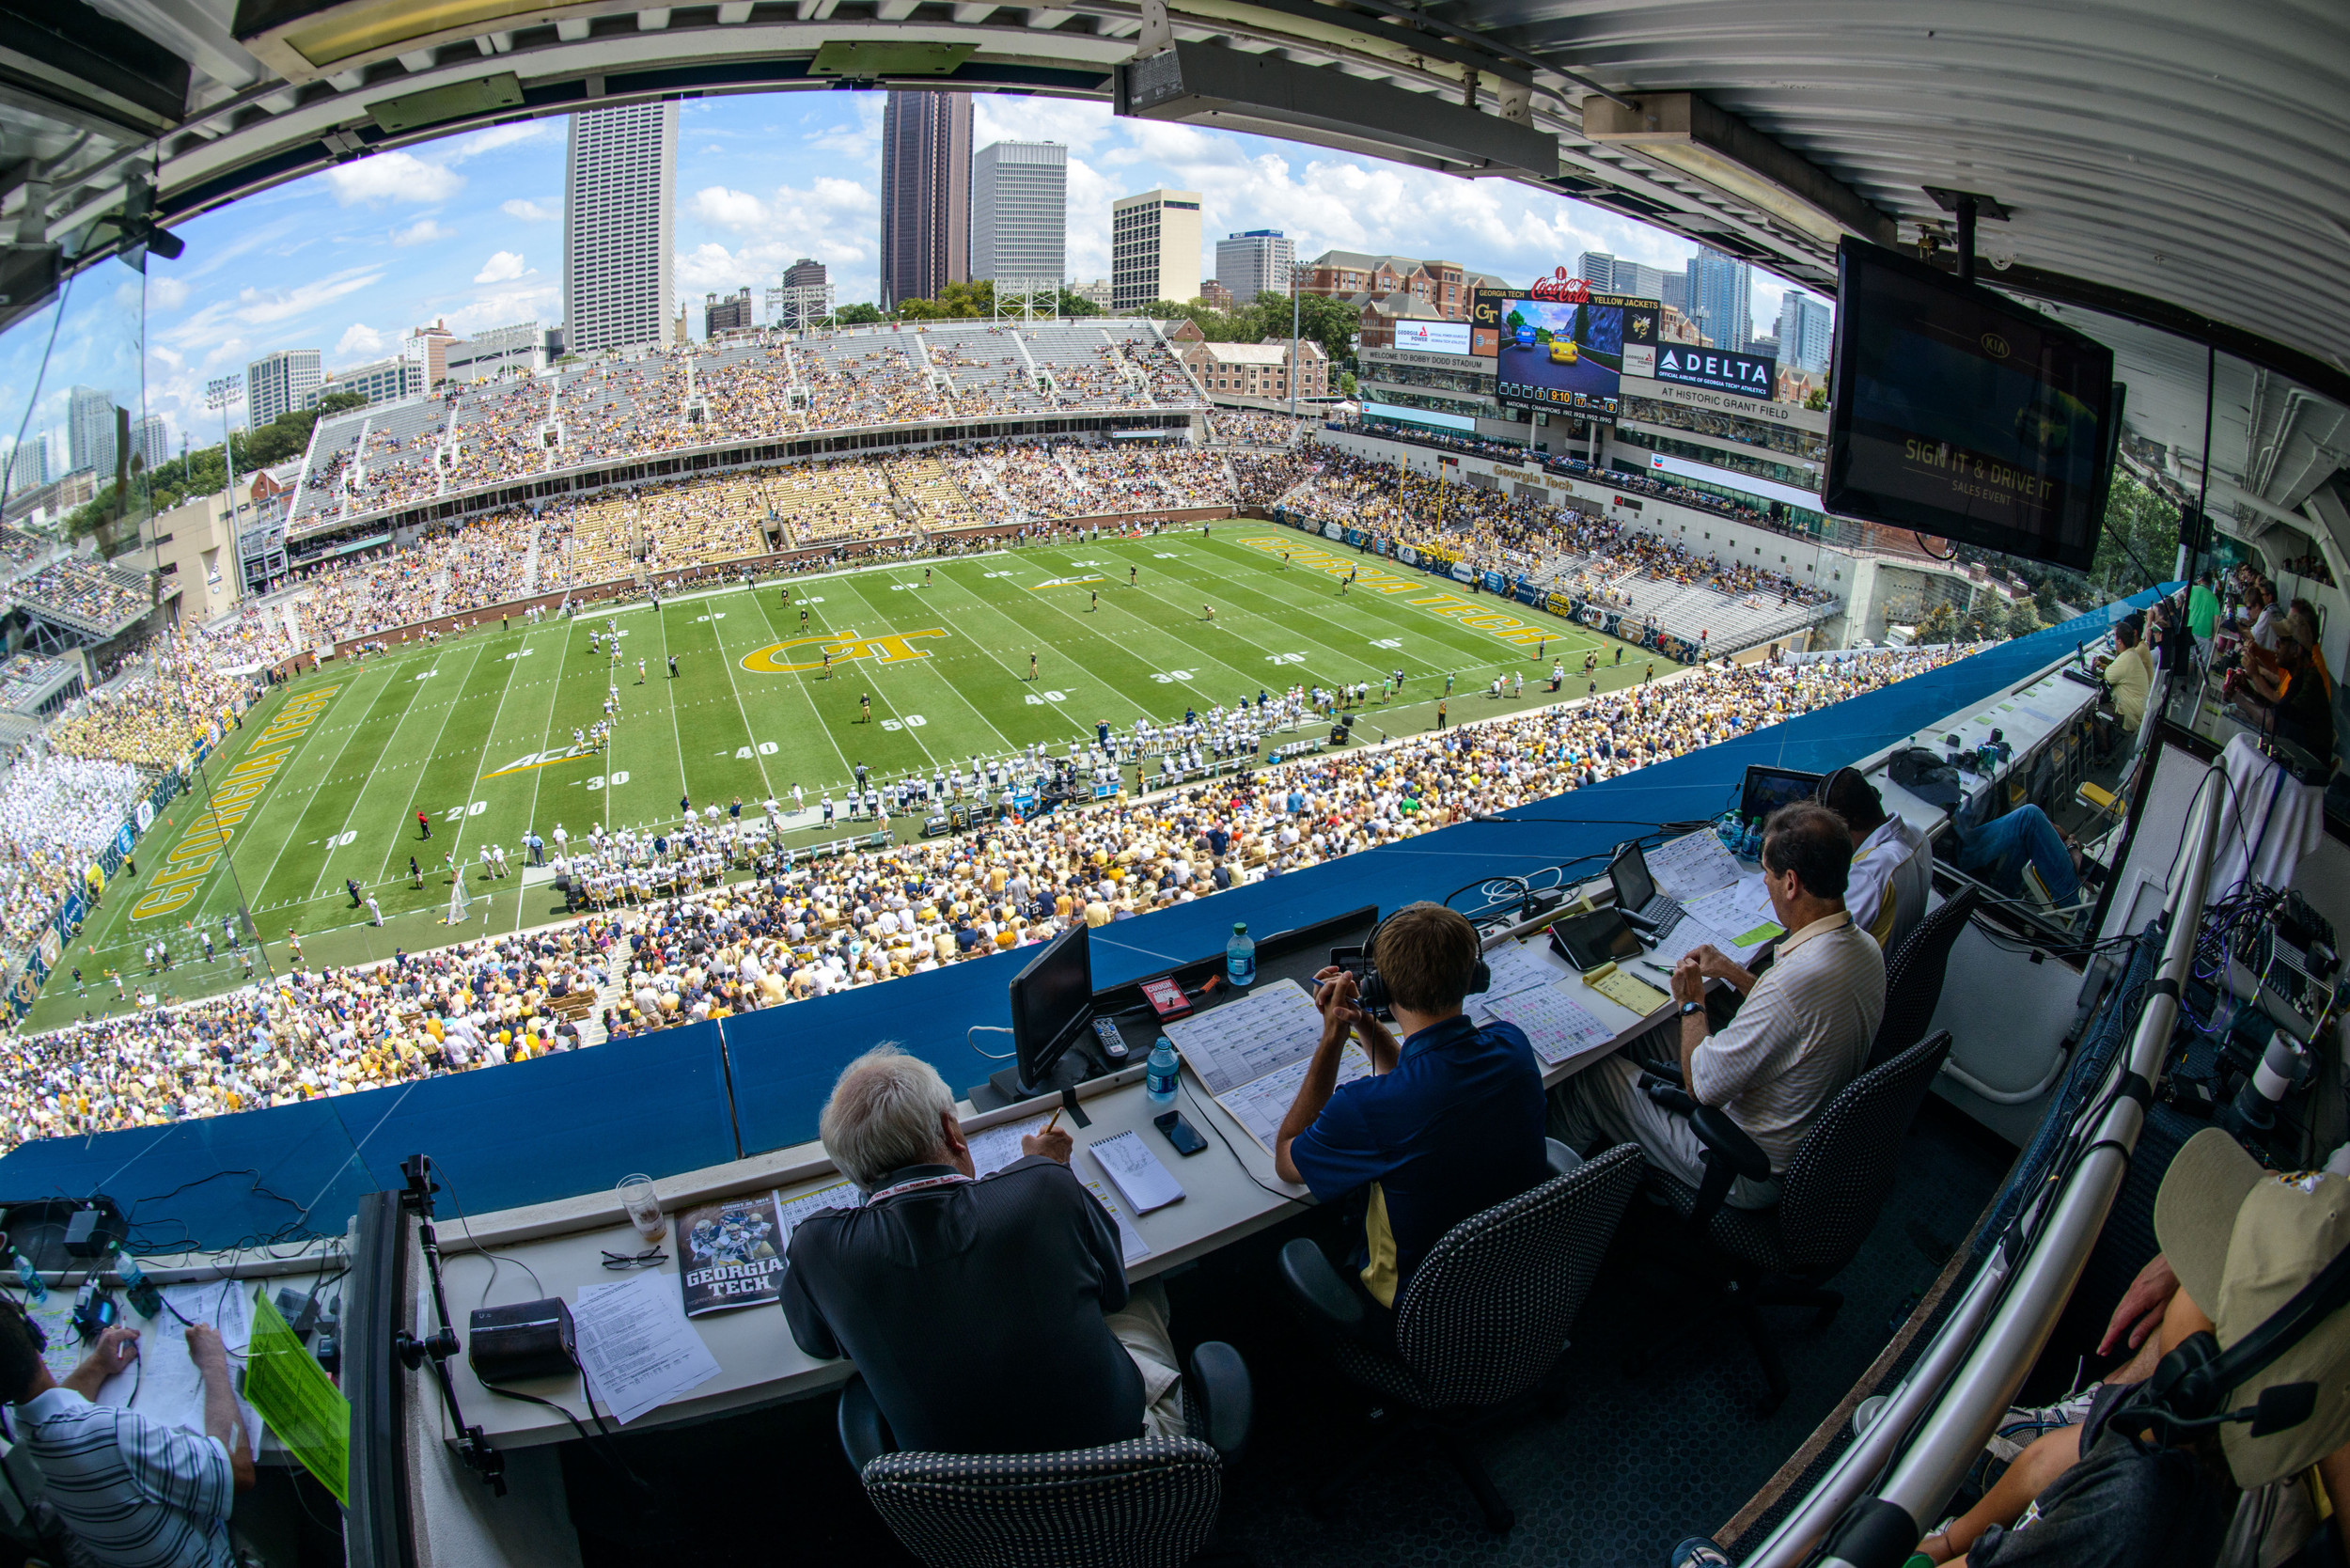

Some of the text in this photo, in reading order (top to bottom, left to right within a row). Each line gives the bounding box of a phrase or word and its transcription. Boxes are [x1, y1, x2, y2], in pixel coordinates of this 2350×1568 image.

[1531, 276, 1594, 304] Coca-Cola
[1594, 296, 1659, 309] YELLOW JACKETS
[1475, 304, 1498, 323] GT
[1985, 336, 2006, 354] KIA
[1370, 352, 1399, 360] WELCOME
[1410, 354, 1431, 363] BOBBY
[1432, 356, 1451, 365] DODD
[1452, 359, 1482, 368] STADIUM
[1686, 353, 1767, 384] DELTA
[1658, 370, 1678, 379] OFFICIAL
[1703, 378, 1724, 386] GEORGIA
[1741, 384, 1766, 395] ATHLETICS
[1551, 390, 1570, 402] 9:10
[1576, 398, 1585, 406] 17
[1662, 387, 1789, 419] AT HISTORIC GRANT FIELD
[1506, 400, 1529, 410] NATIONAL
[1531, 405, 1560, 415] CHAMPIONS
[1608, 403, 1614, 412] 9
[1493, 463, 1574, 493] Georgia Tech
[1905, 438, 2054, 500] SIGN IT & DRIVE IT
[1952, 479, 2012, 506] SALES EVENT
[1034, 573, 1104, 588] ACC
[1236, 537, 1568, 646] GEORGIA TECH
[739, 627, 951, 673] GT
[1369, 638, 1402, 650] 10
[1264, 653, 1306, 666] 20
[1149, 669, 1194, 683] 30
[1025, 690, 1067, 705] 40
[880, 714, 927, 731] 50
[735, 741, 779, 760] 40
[587, 771, 630, 791] 30
[129, 683, 343, 921] GEORGIA TECH
[445, 801, 488, 823] 20
[325, 830, 358, 850] 10
[1147, 980, 1172, 993] COUGH
[721, 1202, 744, 1211] AUGUST
[686, 1258, 784, 1288] GEORGIA
[708, 1276, 772, 1296] TECH
